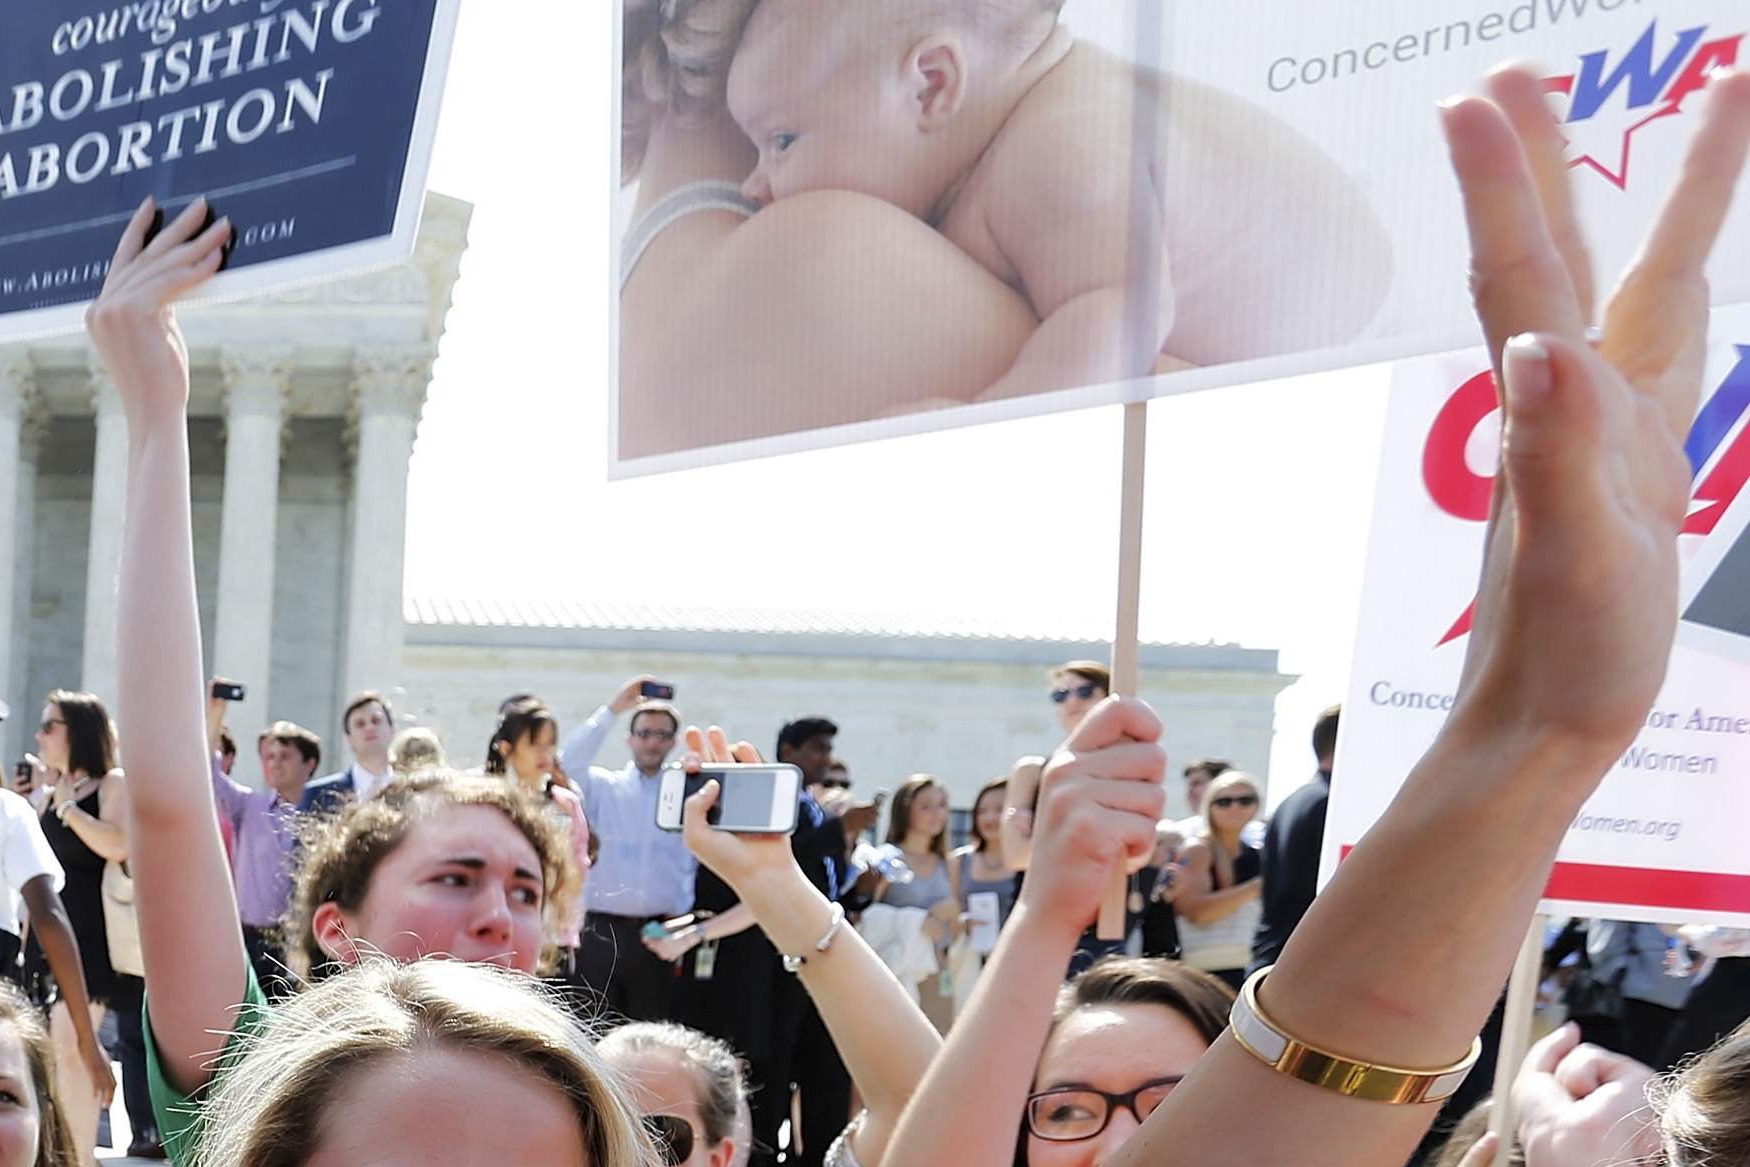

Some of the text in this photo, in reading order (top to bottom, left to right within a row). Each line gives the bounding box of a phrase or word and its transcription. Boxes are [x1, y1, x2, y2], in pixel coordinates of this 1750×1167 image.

[1539, 18, 1747, 124] WA
[1370, 680, 1750, 734] Conce or Ame
[1621, 747, 1718, 775] Women
